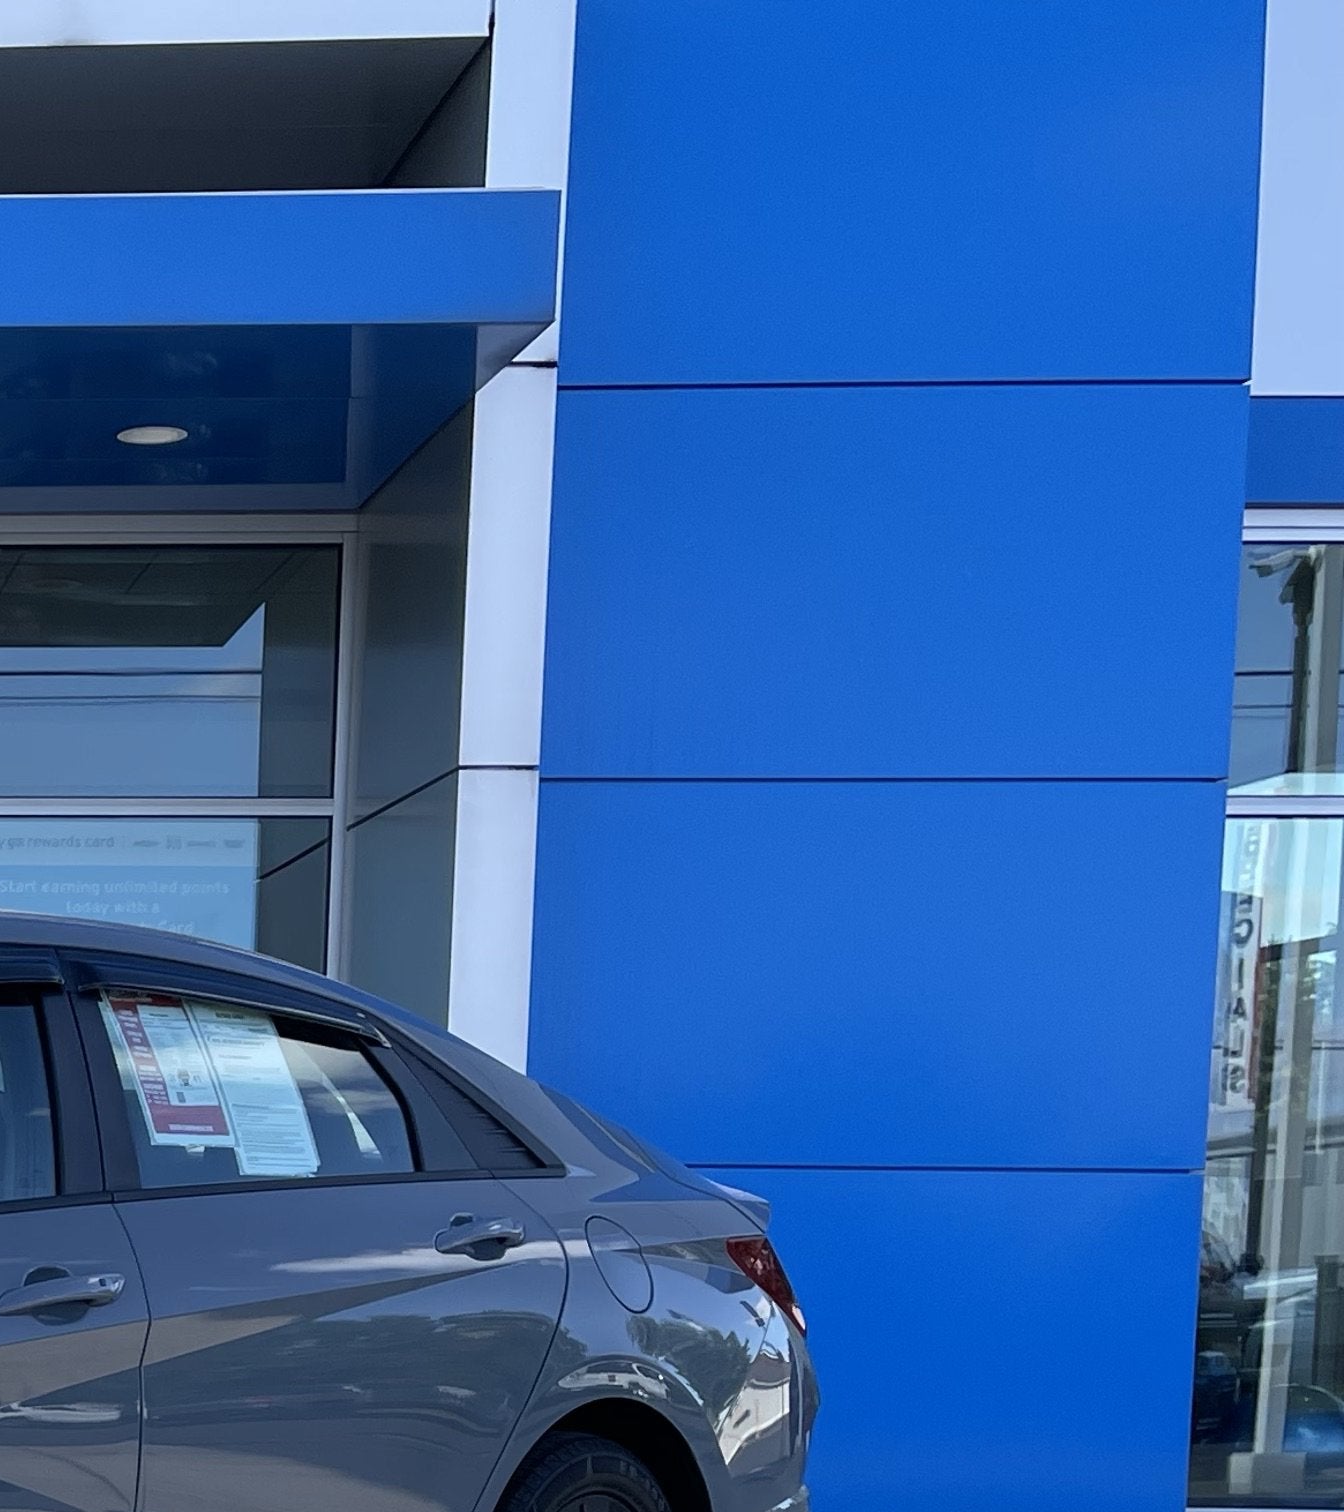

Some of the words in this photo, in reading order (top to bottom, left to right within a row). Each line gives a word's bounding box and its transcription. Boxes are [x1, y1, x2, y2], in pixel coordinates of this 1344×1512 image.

[27, 835, 81, 848] rewards
[85, 835, 115, 848] card
[0, 880, 36, 893] Start
[42, 882, 99, 896] earning
[104, 880, 177, 893] unlimited
[182, 880, 230, 895] points
[66, 902, 110, 915] today
[114, 902, 147, 914] with
